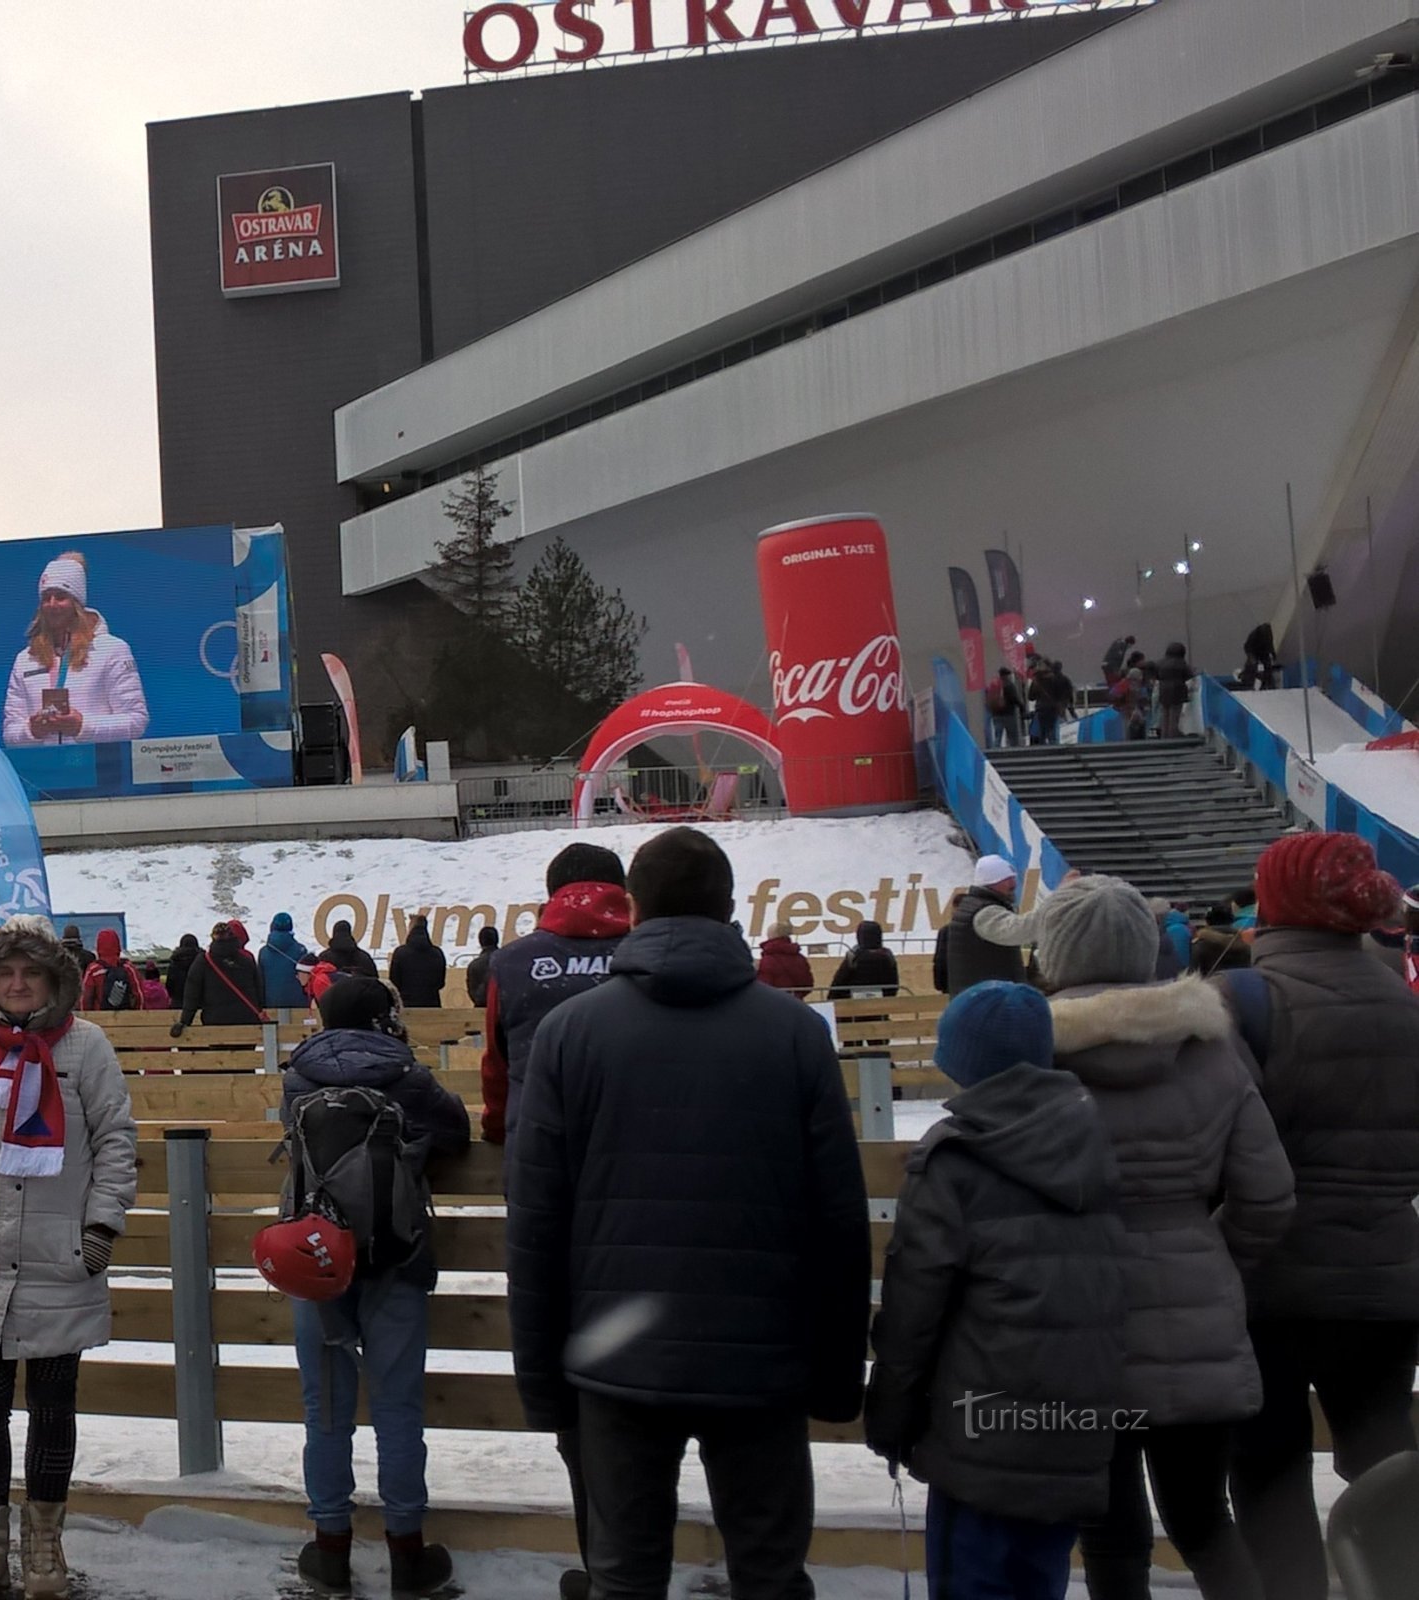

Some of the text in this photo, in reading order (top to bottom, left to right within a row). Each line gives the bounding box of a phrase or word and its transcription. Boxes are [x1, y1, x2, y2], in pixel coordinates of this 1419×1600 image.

[463, 0, 1031, 72] OSTRA
[239, 211, 313, 238] OSTRAVAR
[234, 239, 324, 264] ARÉNA
[782, 544, 876, 566] ORIGINAL TASTE
[748, 869, 1039, 937] festivl
